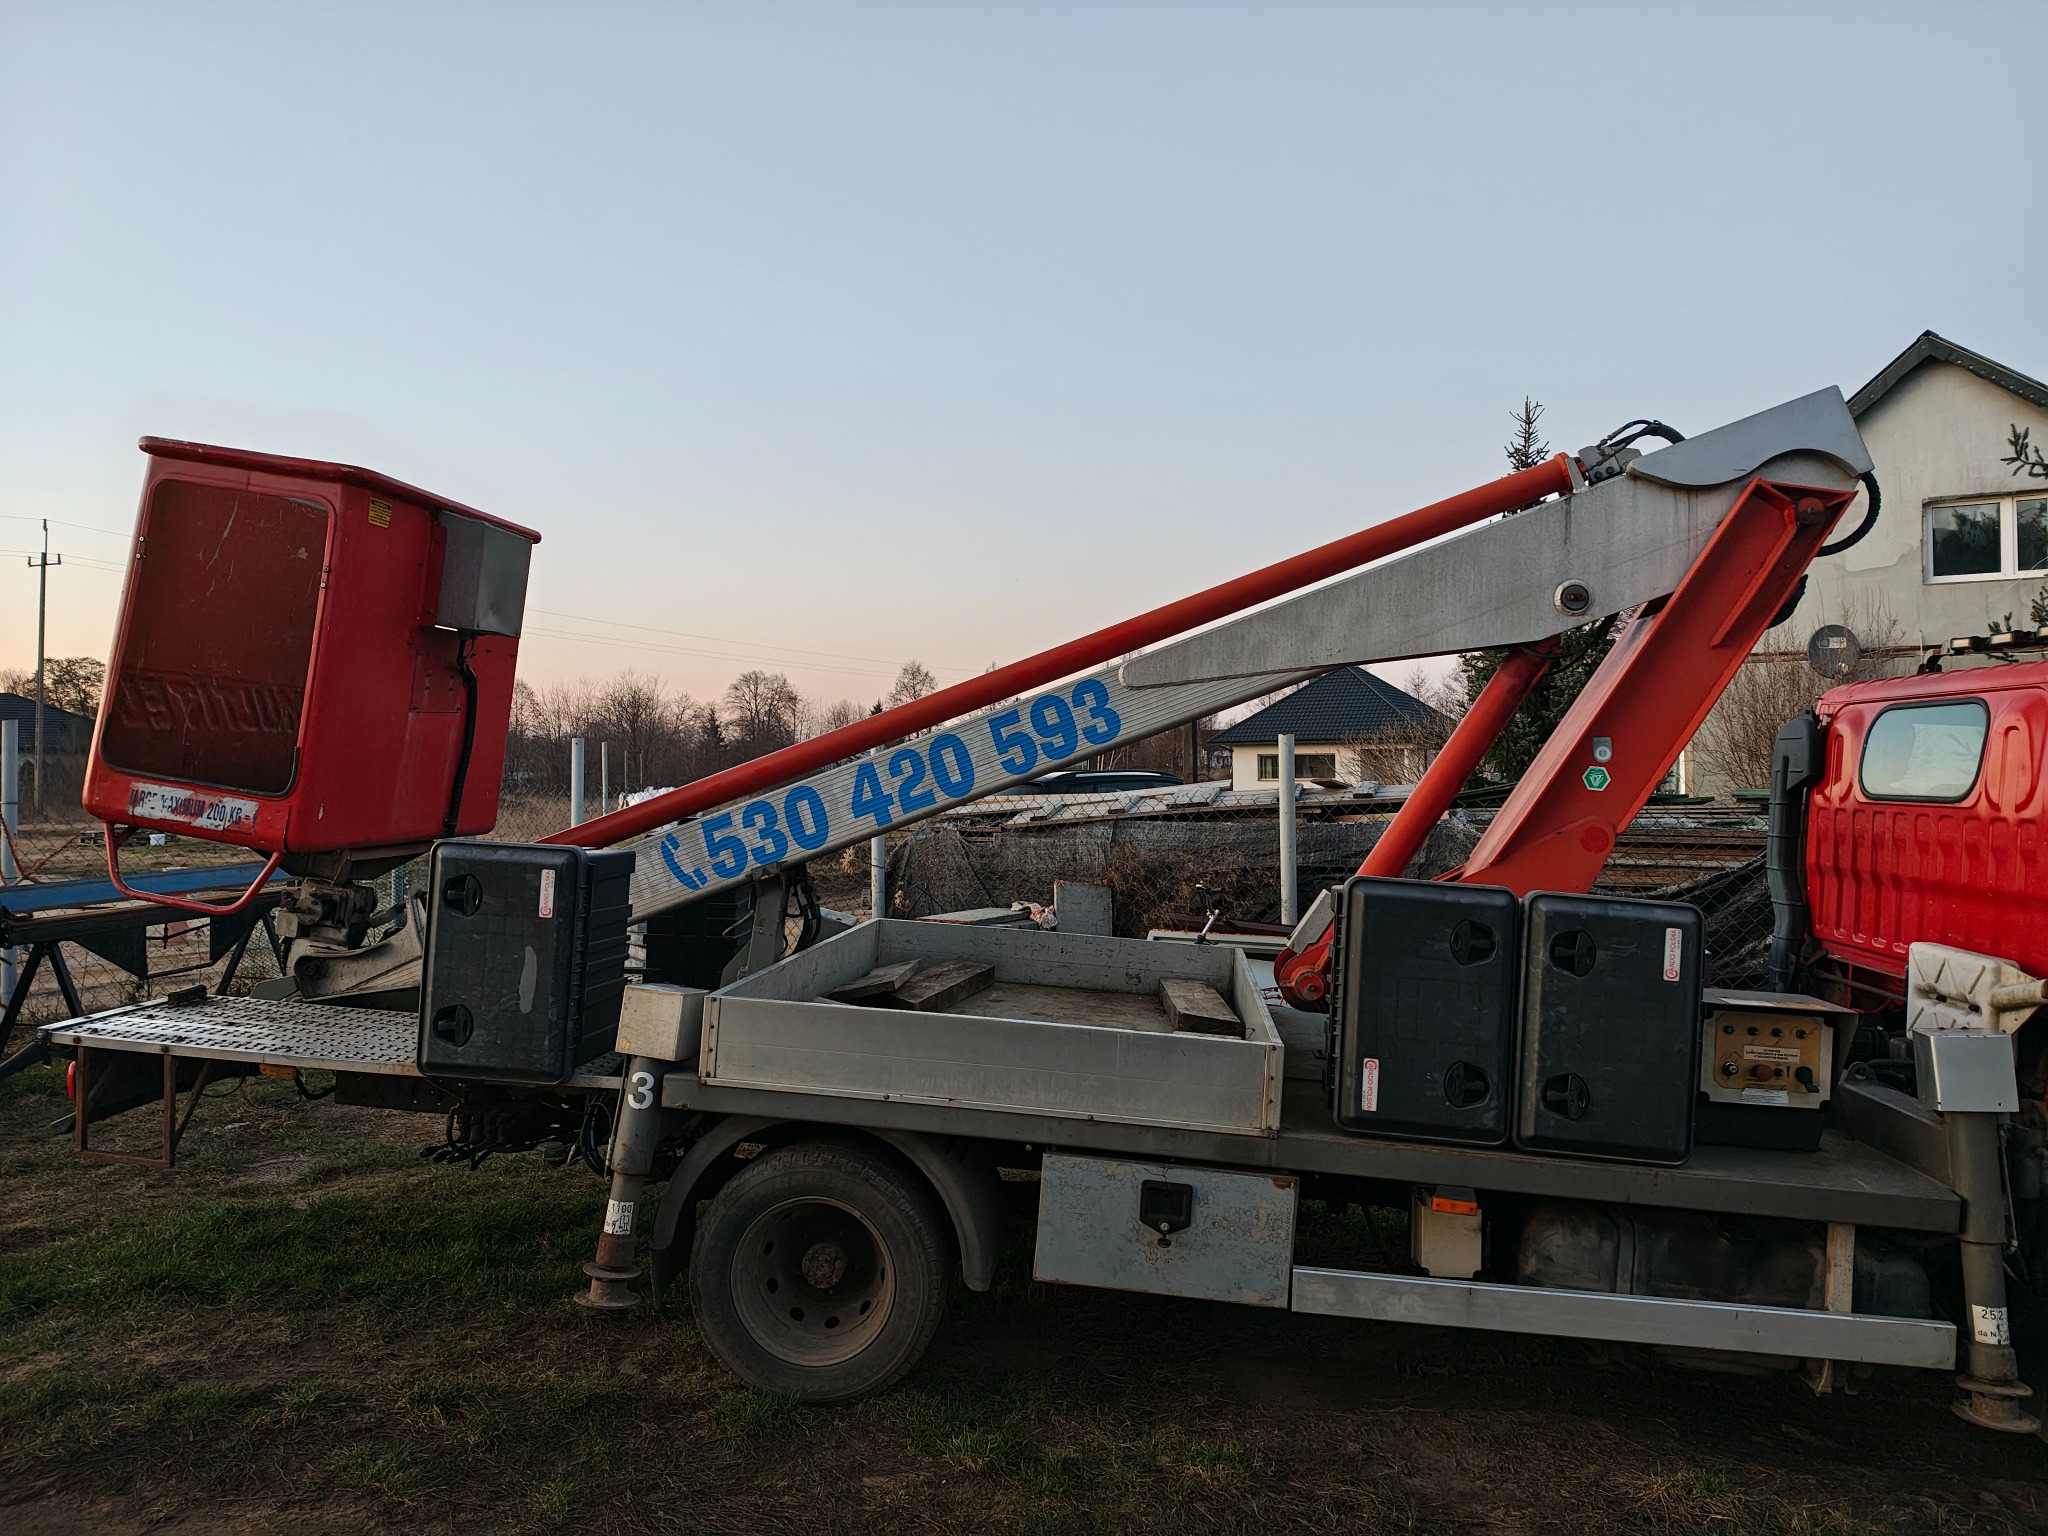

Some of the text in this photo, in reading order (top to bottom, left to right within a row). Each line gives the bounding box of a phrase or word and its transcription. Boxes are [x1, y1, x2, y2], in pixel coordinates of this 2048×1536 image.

[700, 678, 1122, 880] 530 420 593
[206, 802, 227, 822] 200
[626, 1071, 655, 1110] 3
